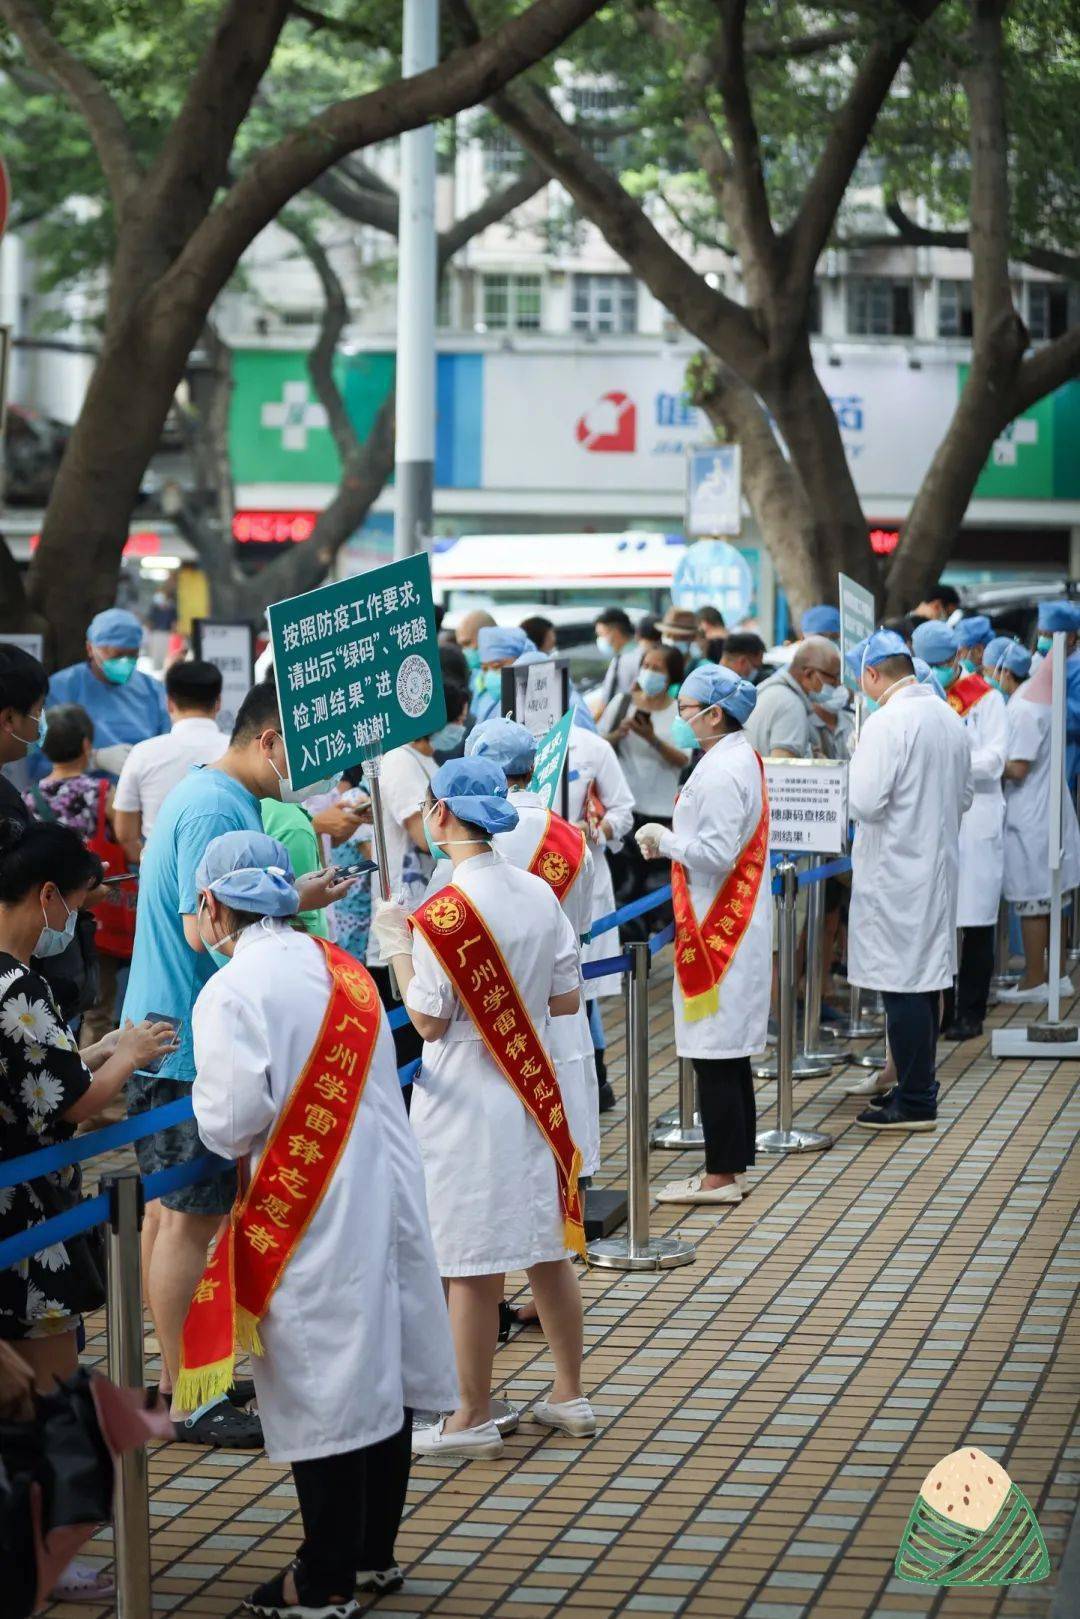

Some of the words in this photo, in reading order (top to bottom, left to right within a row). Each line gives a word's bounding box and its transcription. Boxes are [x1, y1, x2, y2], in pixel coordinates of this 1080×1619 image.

[282, 581, 420, 652] 按照防疫工作要求，
[293, 671, 393, 732] 检测结果”进
[300, 712, 391, 772] 入门诊，谢谢！
[456, 934, 564, 1131] 广州学雷锋志愿者
[243, 1011, 368, 1257] 广州学雷锋志愿者
